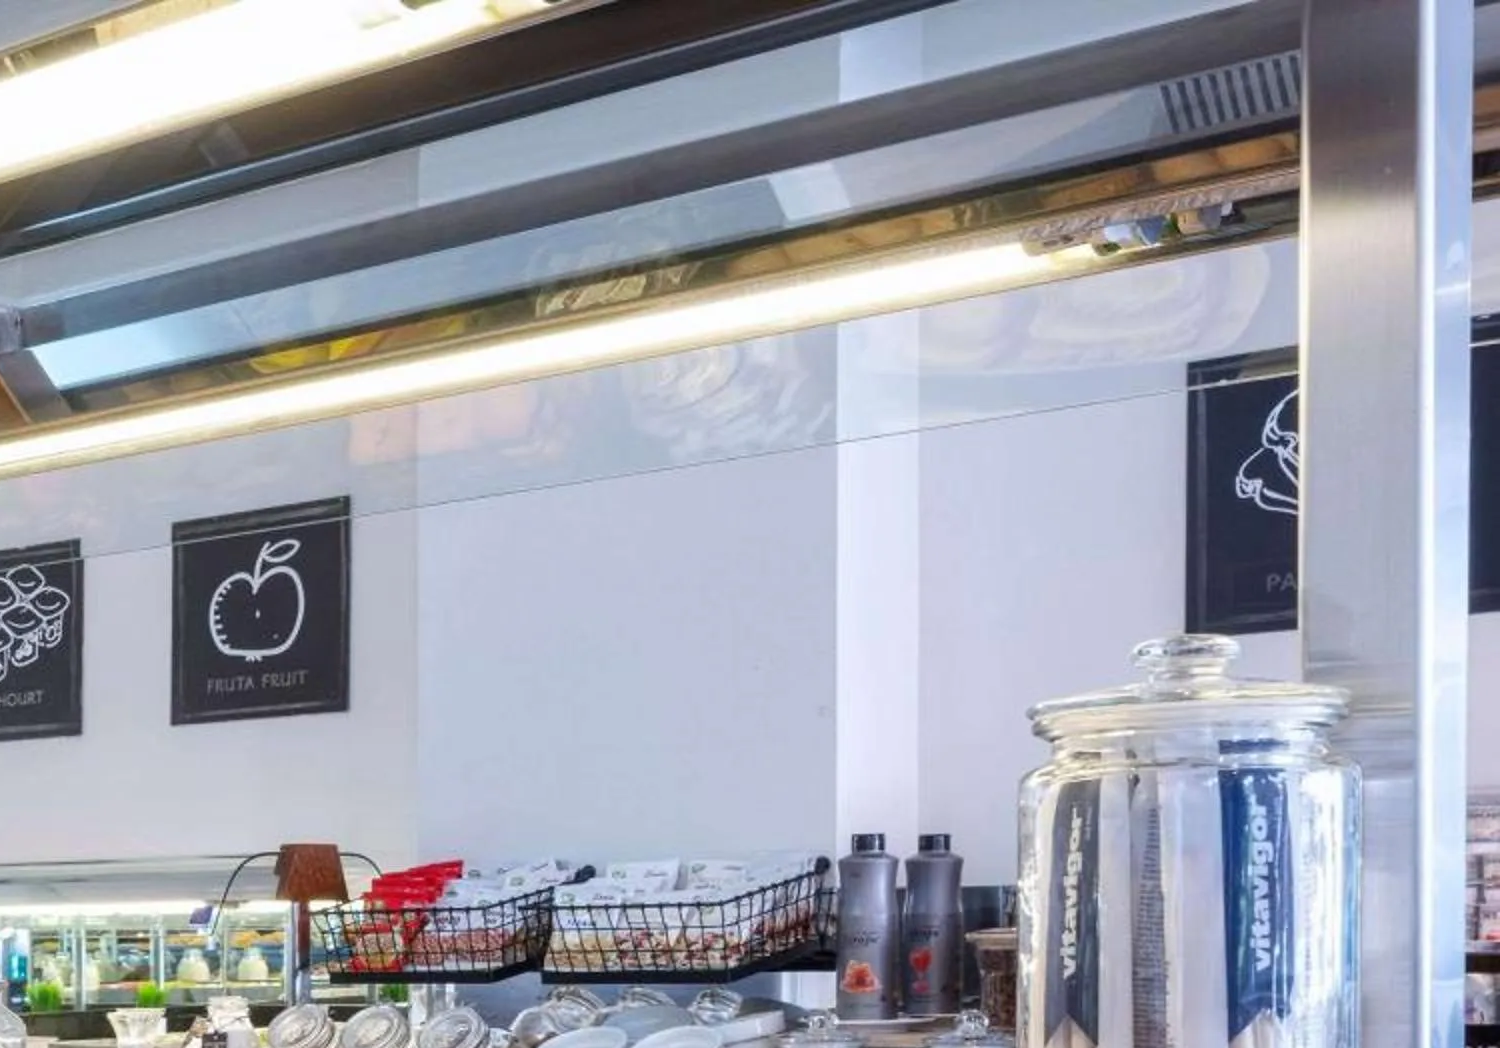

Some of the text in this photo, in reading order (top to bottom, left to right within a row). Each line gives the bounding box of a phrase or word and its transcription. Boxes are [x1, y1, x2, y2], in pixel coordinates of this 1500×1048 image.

[206, 670, 309, 696] FRUTA FRUIT
[1060, 805, 1083, 980] vitavigor
[1250, 795, 1275, 972] vitavigor
